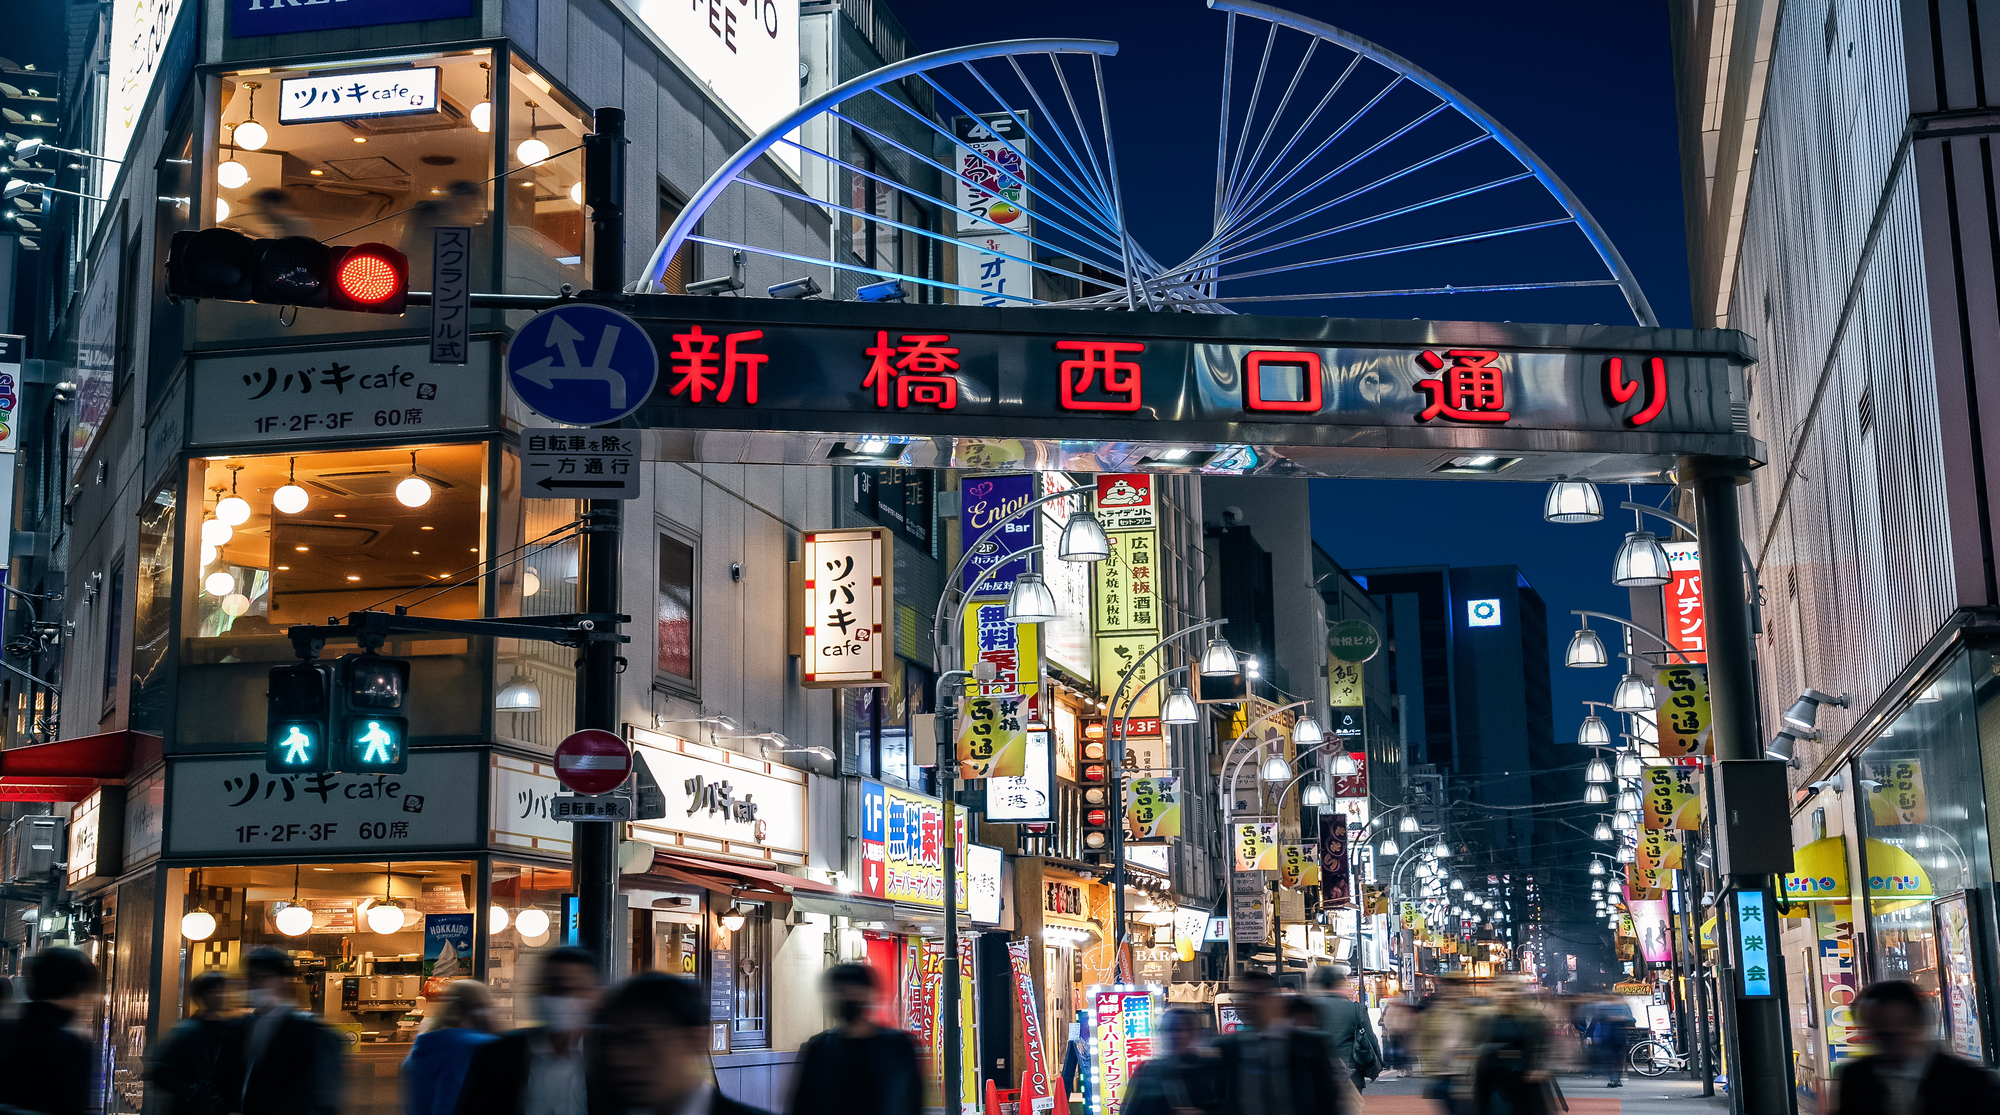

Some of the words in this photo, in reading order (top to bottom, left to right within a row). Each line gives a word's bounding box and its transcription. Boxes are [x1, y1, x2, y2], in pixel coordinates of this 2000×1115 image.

[294, 83, 370, 109] ツバキ
[371, 84, 409, 100] cafe
[437, 232, 464, 359] スクランブル式
[243, 362, 354, 400] ツバキ
[359, 365, 415, 391] cafe
[669, 324, 1667, 426] 新橋西口通り
[374, 407, 424, 427] 60席
[529, 435, 633, 453] 自転車を除く
[530, 457, 631, 475] 一方通行
[967, 493, 1030, 529] Enjoy
[1097, 509, 1152, 518] トライデント
[1005, 522, 1030, 533] Bar
[978, 543, 994, 553] 2F
[826, 555, 857, 636] ツバキ
[1131, 536, 1151, 625] 広島鉄板酒場
[1676, 575, 1703, 651] パチンコ
[822, 639, 862, 657] cafe
[999, 700, 1021, 731] 新橋
[1668, 669, 1700, 753] 西口通り
[970, 700, 994, 775] 西口通り
[1136, 721, 1157, 733] 3F
[224, 772, 340, 808] ツバキ
[344, 774, 402, 801] cafe
[1158, 781, 1175, 803] 新橋
[1676, 770, 1694, 795] 新橋
[559, 802, 625, 816] 自転車を除く
[684, 774, 736, 821] ツバキ
[734, 793, 759, 823] cafe
[864, 792, 883, 833] 1F
[1135, 780, 1154, 836] 西口通り
[1651, 770, 1673, 827] 西口通り
[358, 820, 410, 840] 60席
[1260, 826, 1273, 844] 新橋
[1242, 825, 1257, 868] 西口通り
[1286, 847, 1300, 885] 西口通り
[1784, 876, 1837, 892] uno
[429, 924, 469, 935] HOKKAIDO
[1742, 905, 1767, 982] 共栄会
[1135, 950, 1170, 961] BAR
